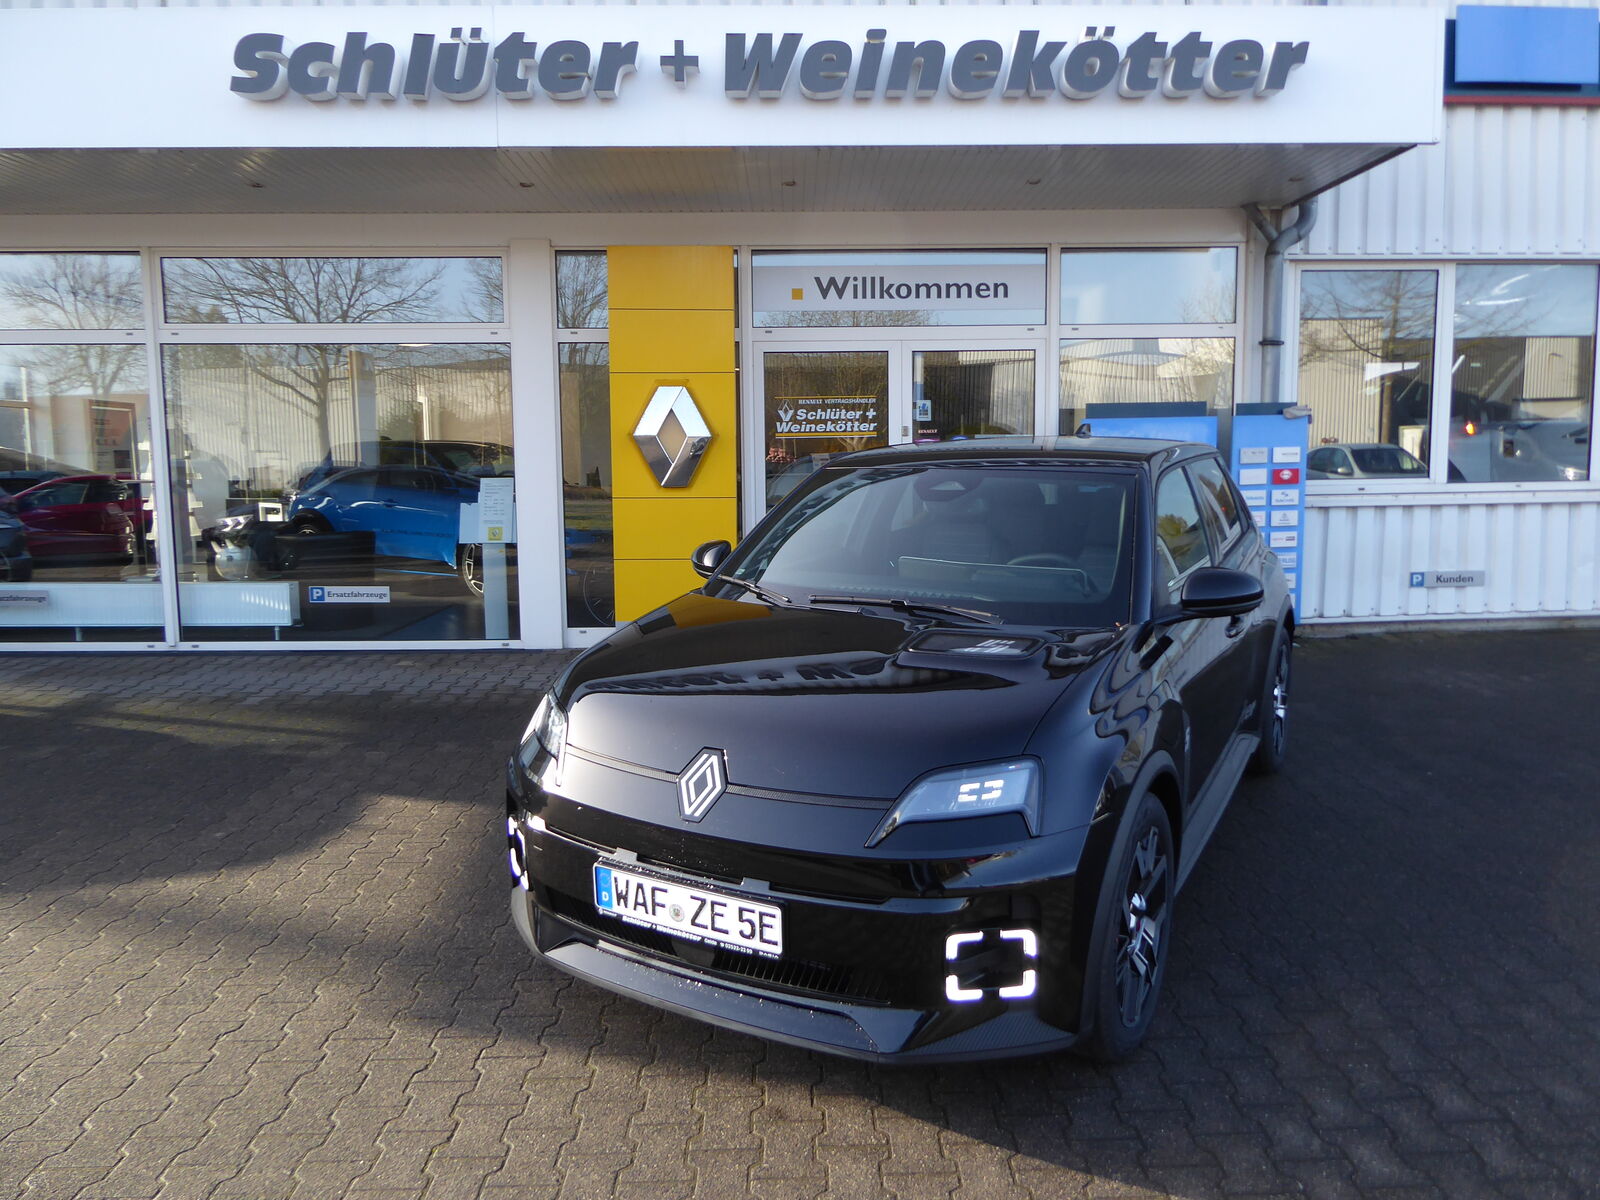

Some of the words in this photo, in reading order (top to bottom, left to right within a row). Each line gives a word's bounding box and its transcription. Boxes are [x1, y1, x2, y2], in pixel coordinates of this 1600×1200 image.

[230, 27, 640, 100] Schlüter
[660, 39, 700, 89] +
[724, 27, 1310, 100] Weinekötter
[813, 275, 1009, 300] Willkommen
[796, 407, 865, 420] Schlüter
[865, 408, 877, 419] +
[776, 420, 877, 433] Weinekötter
[1412, 574, 1422, 586] P
[1435, 574, 1474, 583] Kunden
[312, 588, 322, 600] P
[327, 590, 388, 599] Ersatzfahrzeuge
[613, 876, 669, 916] WAF
[690, 895, 730, 935] ZE
[738, 906, 779, 946] 5E
